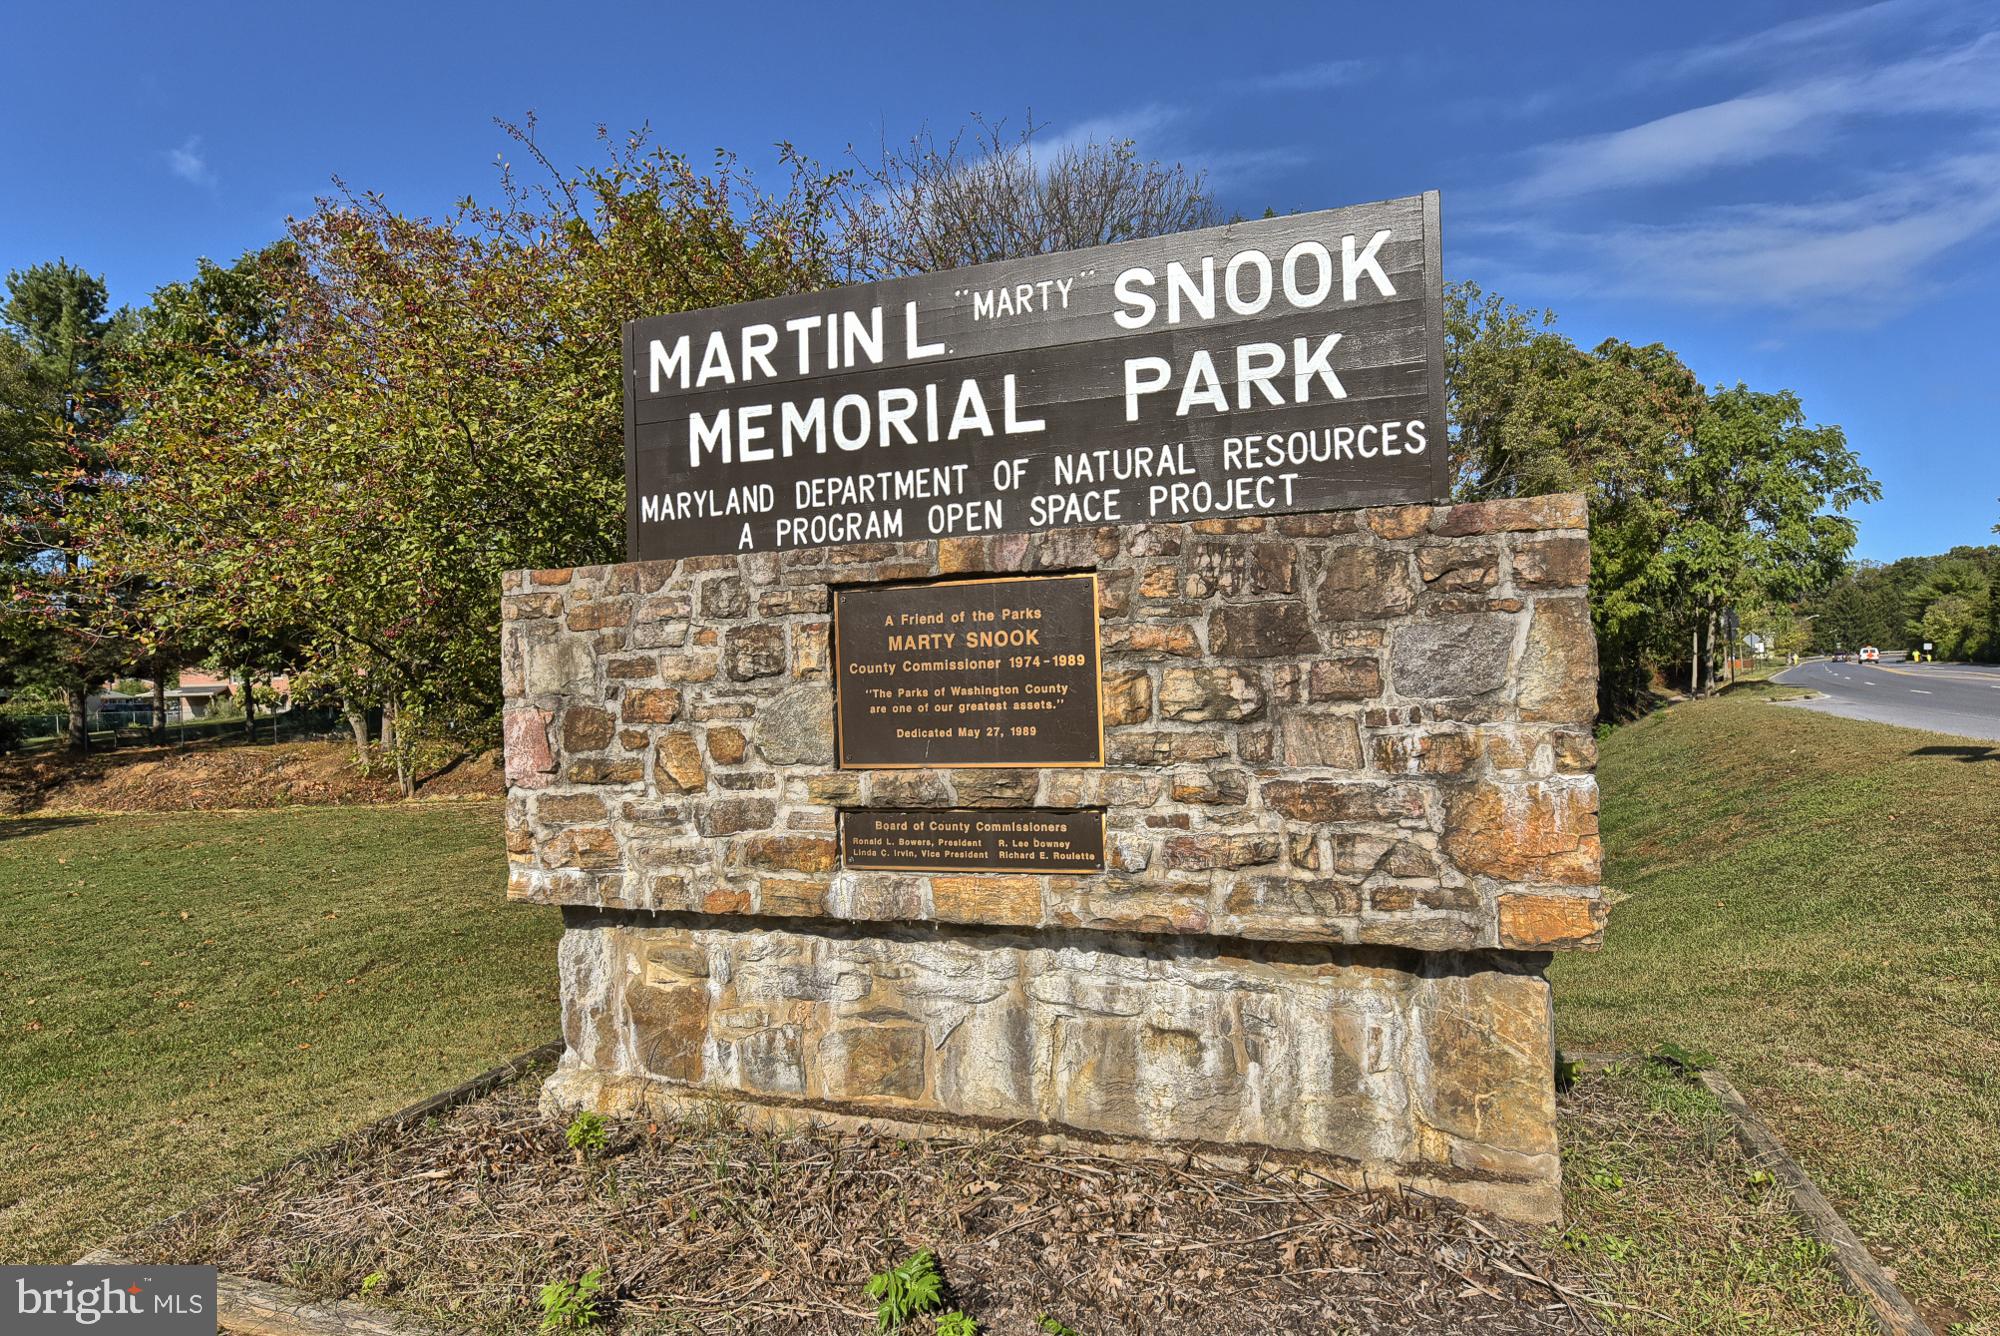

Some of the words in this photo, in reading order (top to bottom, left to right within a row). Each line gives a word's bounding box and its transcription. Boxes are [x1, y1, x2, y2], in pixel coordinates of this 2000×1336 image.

[649, 306, 884, 393] MARTIN
[1113, 229, 1397, 329] SNOOK
[688, 373, 1046, 467] MEMORIAL
[1124, 333, 1347, 421] PARK
[641, 483, 775, 523] MARYLAND
[795, 464, 969, 510] DEPARTMENT
[992, 458, 1029, 491] OF
[1054, 444, 1196, 486] NATURAL
[1223, 420, 1427, 471] RESOURCES
[738, 522, 755, 550] A
[776, 508, 904, 546] PROGRAM
[928, 500, 1003, 534] OPEN
[1029, 489, 1121, 527] SPACE
[1149, 473, 1299, 517] PROJECT
[885, 615, 894, 626] A
[901, 612, 944, 625] Friend
[951, 611, 966, 623] of
[972, 610, 995, 622] the
[1002, 608, 1042, 620] Parks
[888, 634, 956, 651] MARTY
[966, 629, 1040, 648] SNOOK
[849, 661, 896, 675] County
[903, 658, 1001, 672] Commissioner
[898, 687, 929, 698] Parks
[934, 687, 946, 697] of
[951, 685, 1019, 696] Washington
[1025, 684, 1068, 695] County
[870, 705, 887, 714] are
[892, 704, 912, 713] one
[917, 703, 929, 713] of
[934, 702, 954, 712] our
[959, 701, 1007, 713] greatest
[897, 728, 953, 738] Dedicated
[958, 727, 980, 739] May
[986, 727, 1004, 739] 27,
[1010, 726, 1037, 736] 1989
[875, 821, 908, 831] Board
[913, 821, 925, 831] of
[930, 821, 970, 833] County
[976, 821, 1068, 833] Commissioners
[886, 838, 895, 846] L.
[899, 838, 934, 847] Bowers,
[938, 839, 982, 847] President
[998, 839, 1008, 847] R.
[1033, 838, 1071, 849] Downey
[881, 849, 890, 857] C.
[894, 849, 918, 858] Irvin,
[921, 850, 940, 858] Vice
[945, 850, 989, 858] President
[999, 851, 1037, 860] Richard
[1040, 851, 1049, 860] E.
[1053, 851, 1096, 860] Roulette
